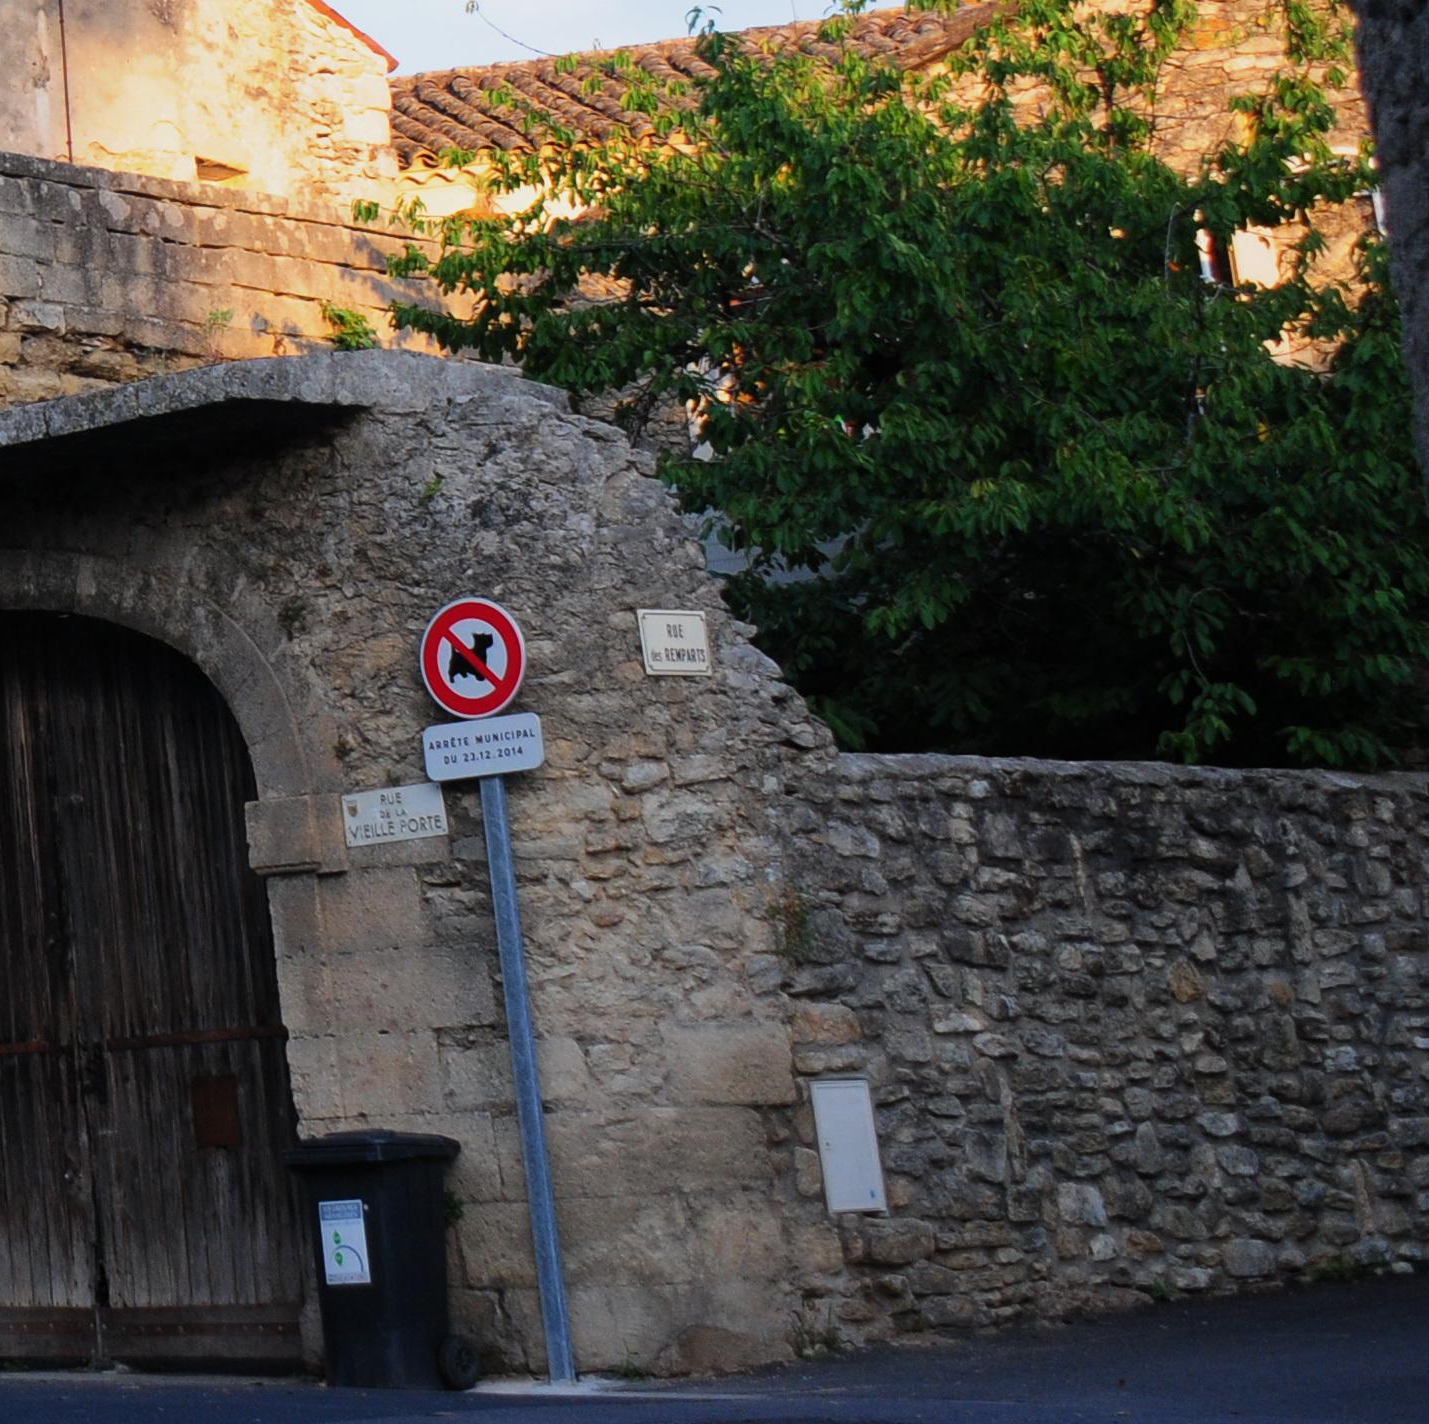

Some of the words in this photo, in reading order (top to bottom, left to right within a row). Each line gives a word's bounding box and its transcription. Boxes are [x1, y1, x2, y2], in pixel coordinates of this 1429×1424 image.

[666, 623, 684, 638] RUE
[651, 649, 662, 662] des
[664, 647, 705, 662] REMPARTS
[475, 728, 535, 744] MUNICIPAL
[444, 754, 457, 765] DU
[380, 792, 402, 805] RUE
[380, 810, 391, 819] DE
[396, 808, 407, 817] LA
[348, 821, 395, 839] VIEILLE
[400, 814, 441, 833] PORTE
